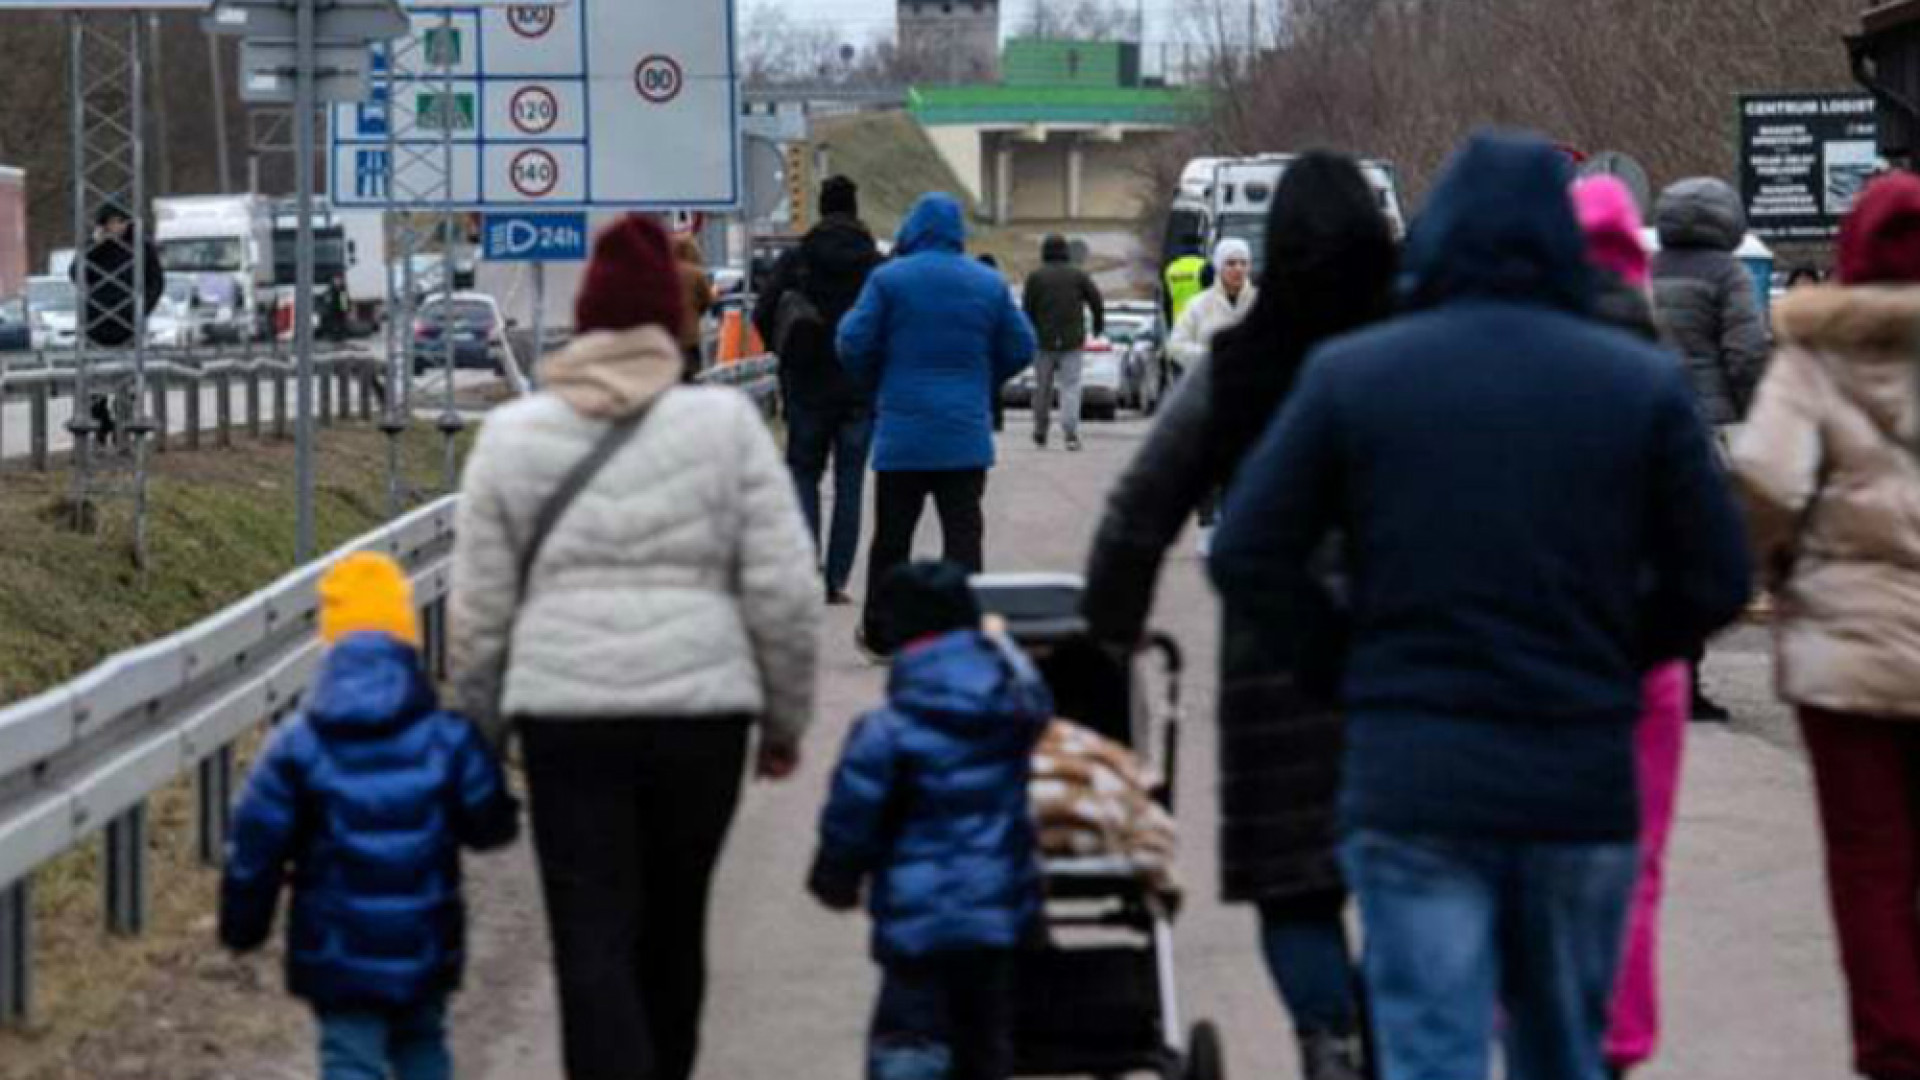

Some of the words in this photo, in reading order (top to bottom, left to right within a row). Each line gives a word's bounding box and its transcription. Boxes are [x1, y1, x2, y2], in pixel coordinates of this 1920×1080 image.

[516, 101, 550, 119] 120
[1745, 101, 1819, 116] CENTRUM
[514, 163, 550, 181] 140
[540, 226, 581, 249] 24h
